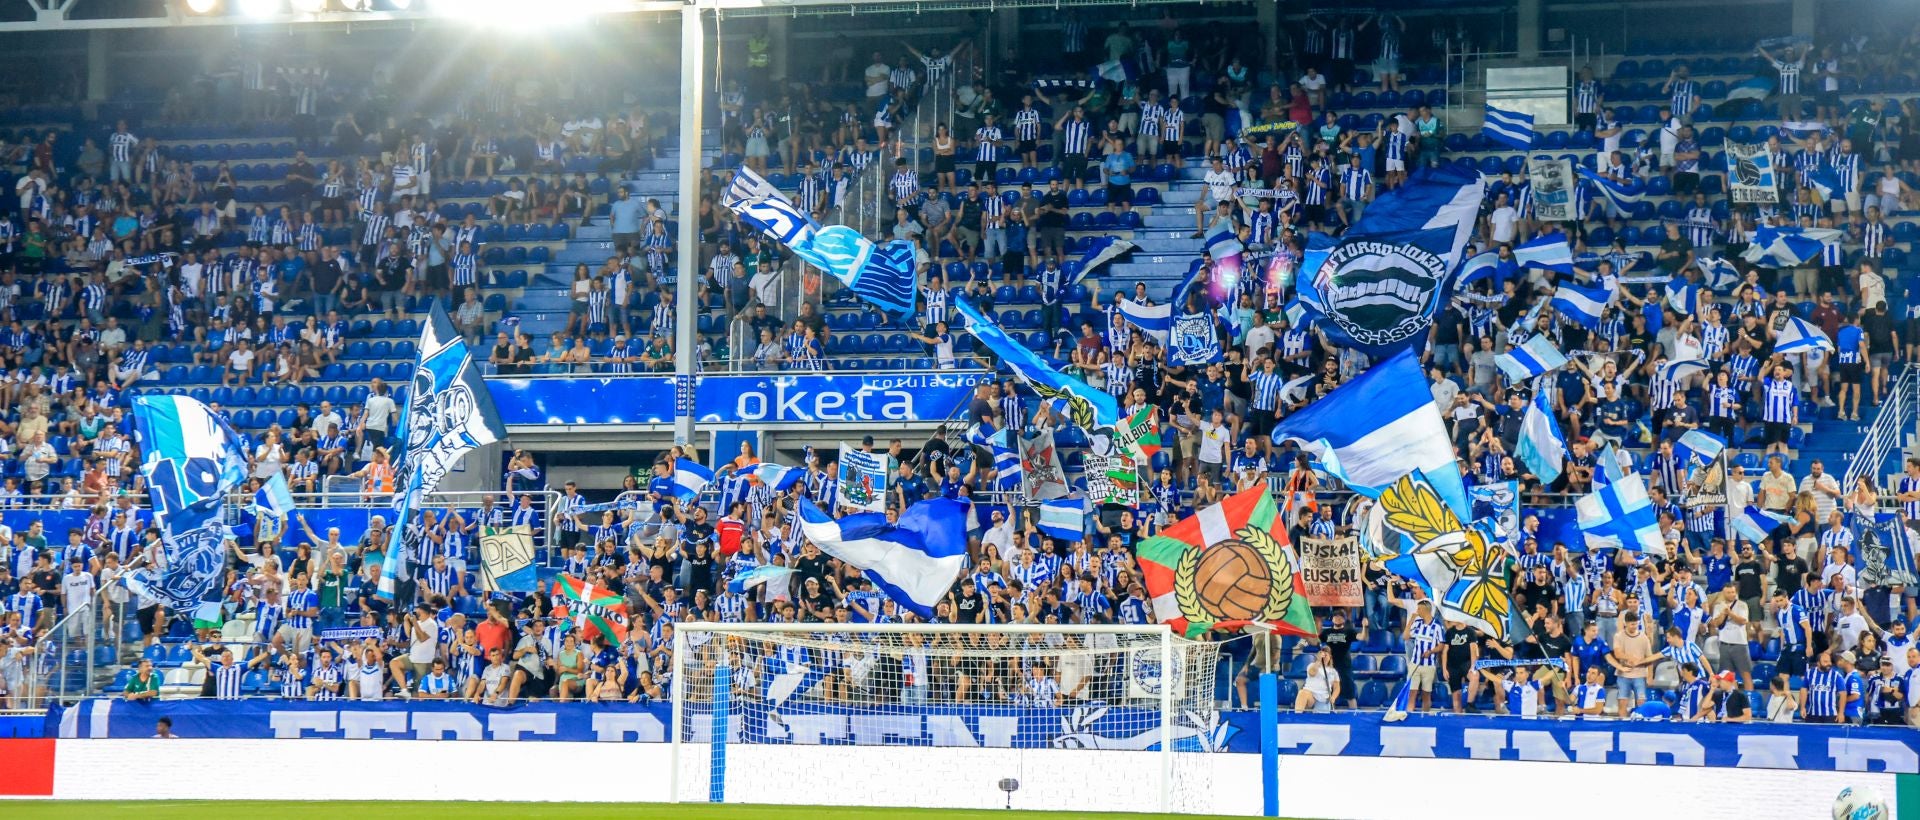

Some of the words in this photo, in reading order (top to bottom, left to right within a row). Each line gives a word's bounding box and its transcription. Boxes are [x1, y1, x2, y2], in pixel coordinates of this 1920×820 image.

[738, 376, 913, 420] oketa
[1302, 541, 1355, 558] EUSKAL
[1303, 568, 1358, 583] EUSKAL
[1123, 604, 1140, 623] 21
